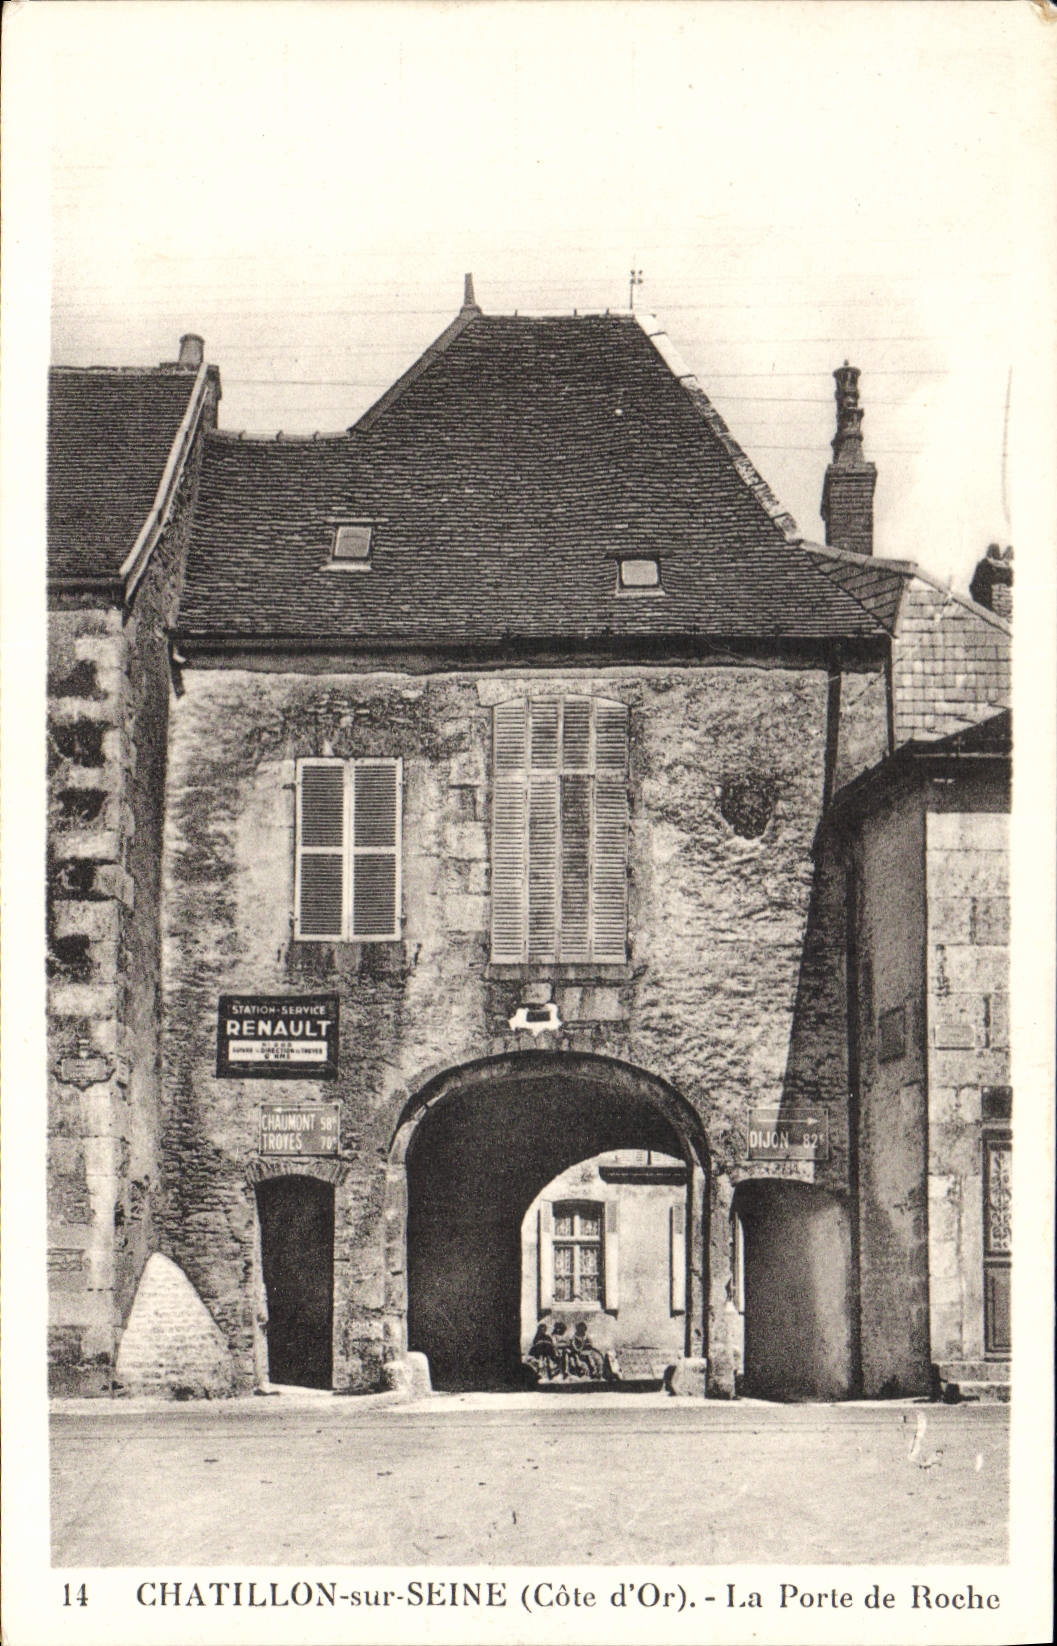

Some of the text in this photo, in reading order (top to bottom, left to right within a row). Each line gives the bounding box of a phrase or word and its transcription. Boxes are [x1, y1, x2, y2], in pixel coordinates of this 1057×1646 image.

[226, 1019, 332, 1037] RENAULT
[262, 1113, 315, 1131] CHAUMONT
[262, 1133, 302, 1150] TROYES
[750, 1130, 789, 1149] DIJON
